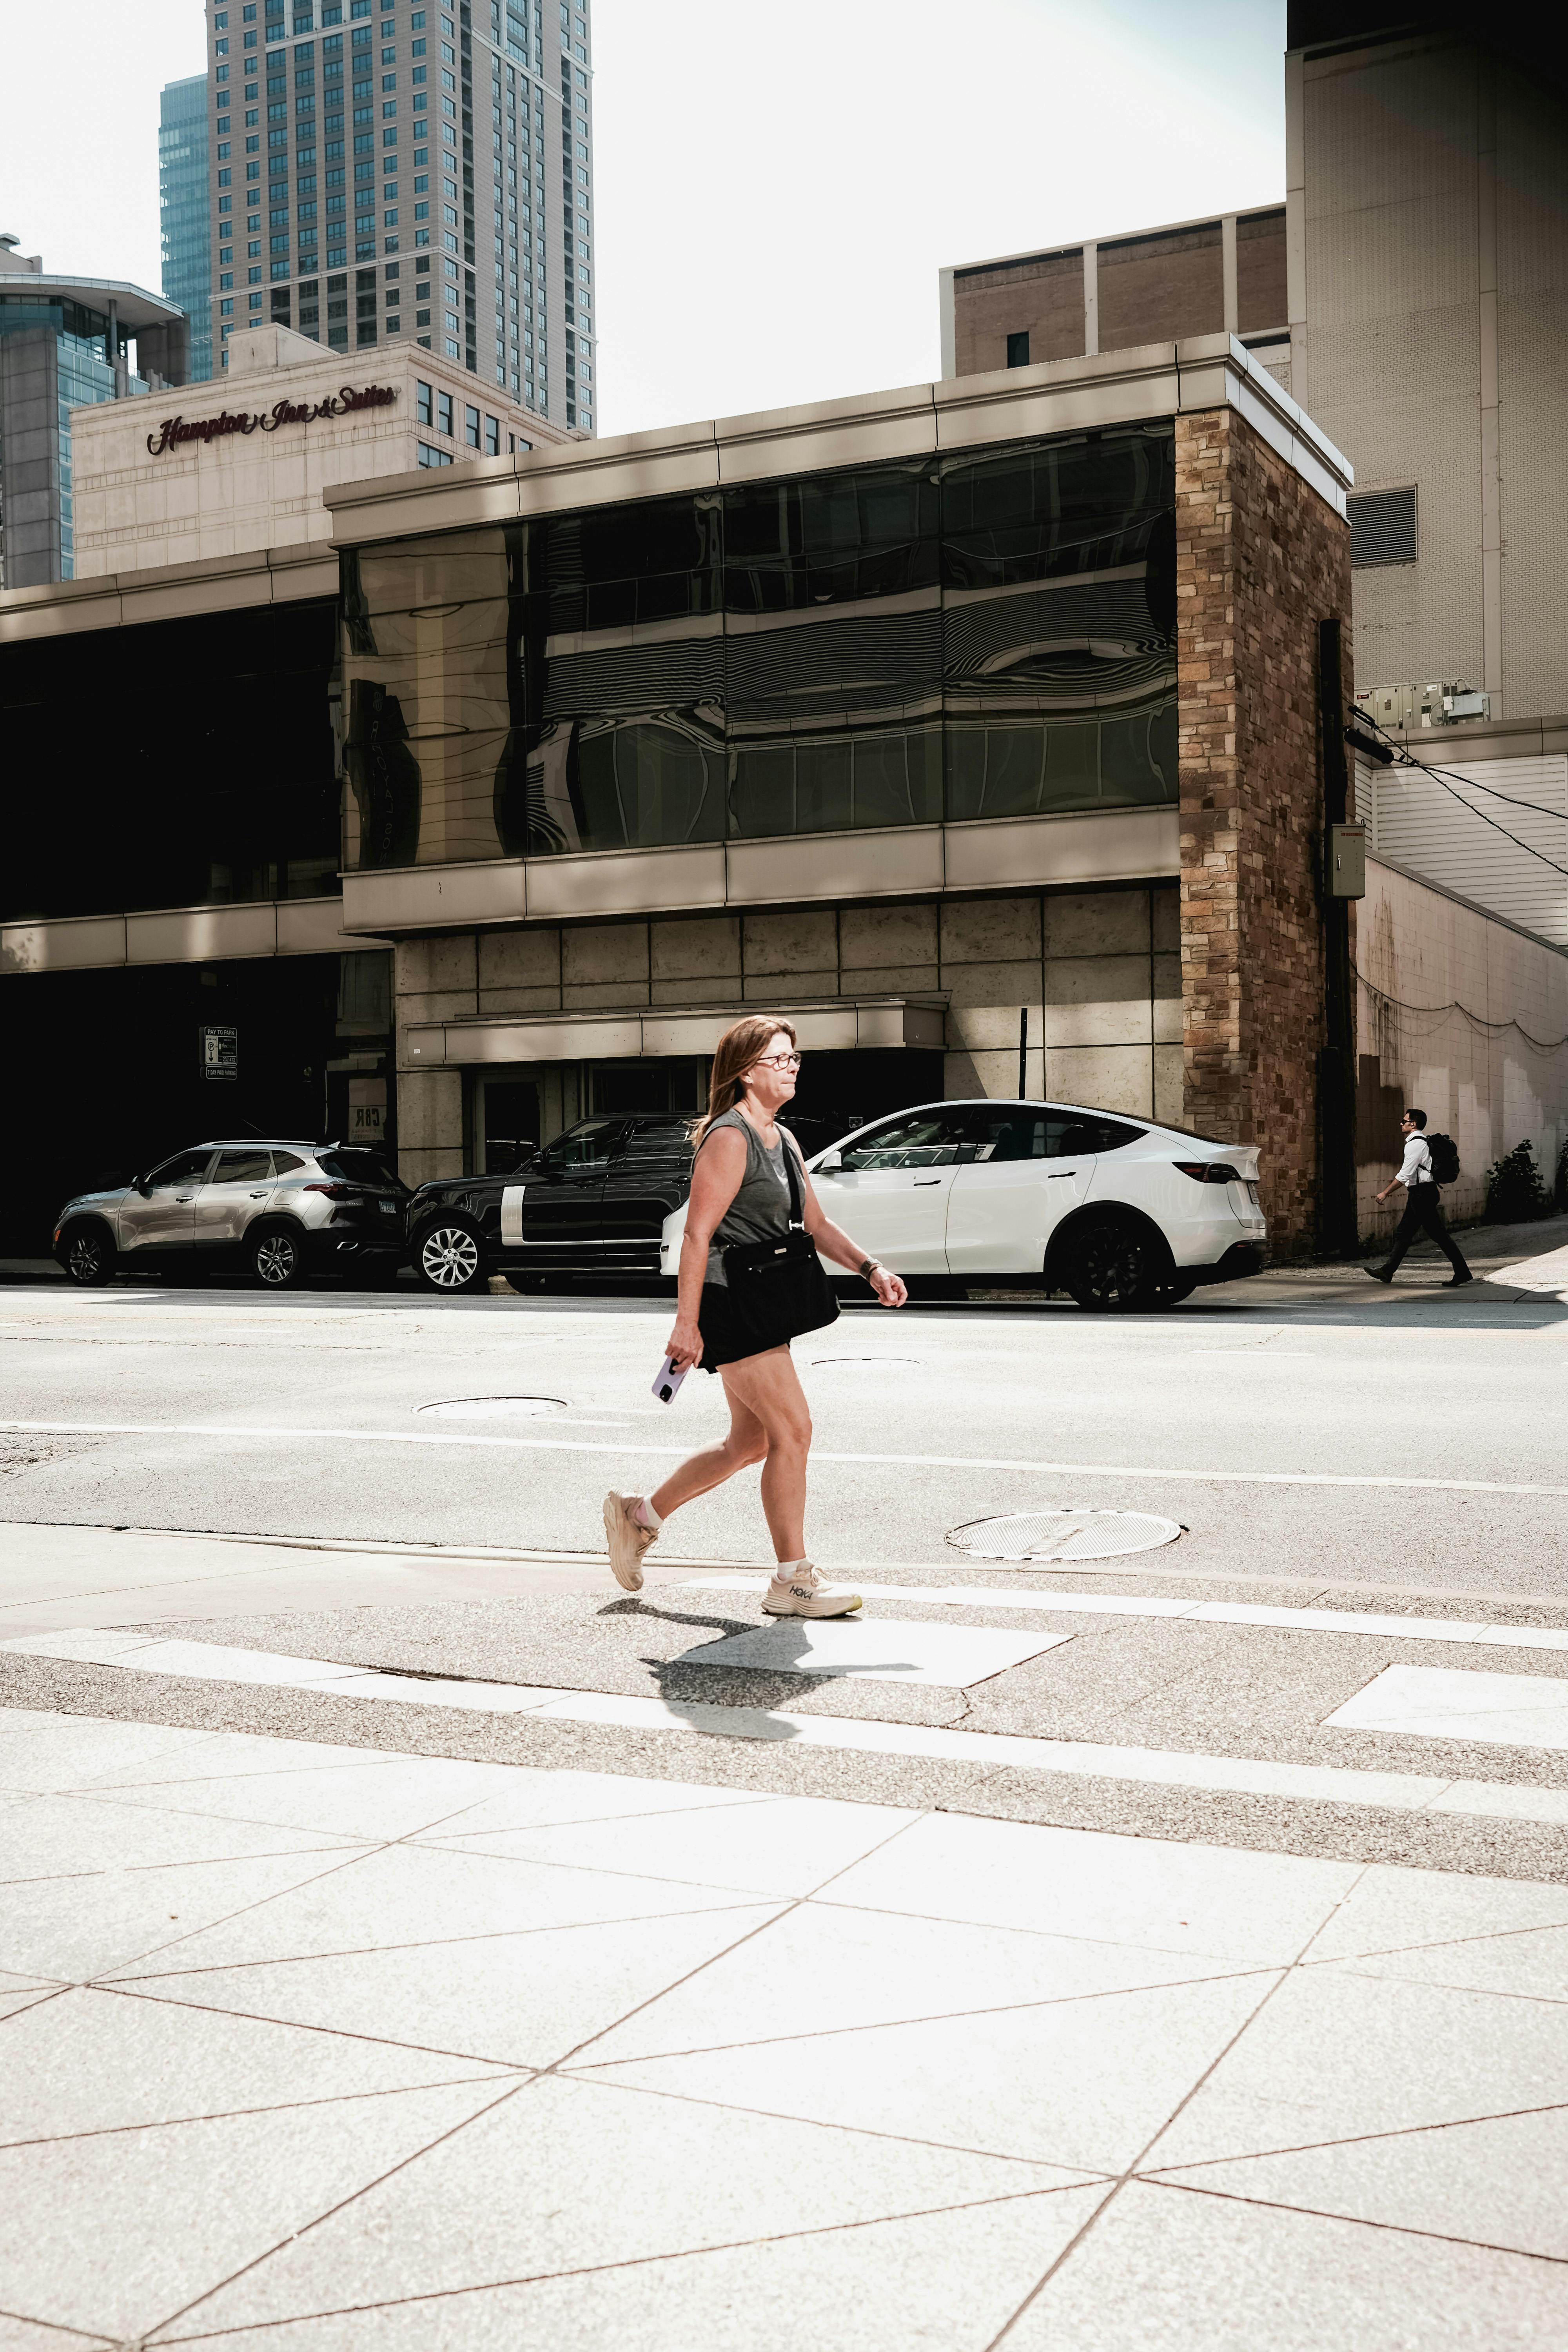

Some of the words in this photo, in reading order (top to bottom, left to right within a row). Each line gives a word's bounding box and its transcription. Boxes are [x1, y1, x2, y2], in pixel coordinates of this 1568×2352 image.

[147, 411, 258, 456] Hampton
[260, 400, 318, 432] Inn
[318, 399, 334, 419] &
[331, 385, 394, 415] Suites
[789, 1585, 814, 1600] HOKA
